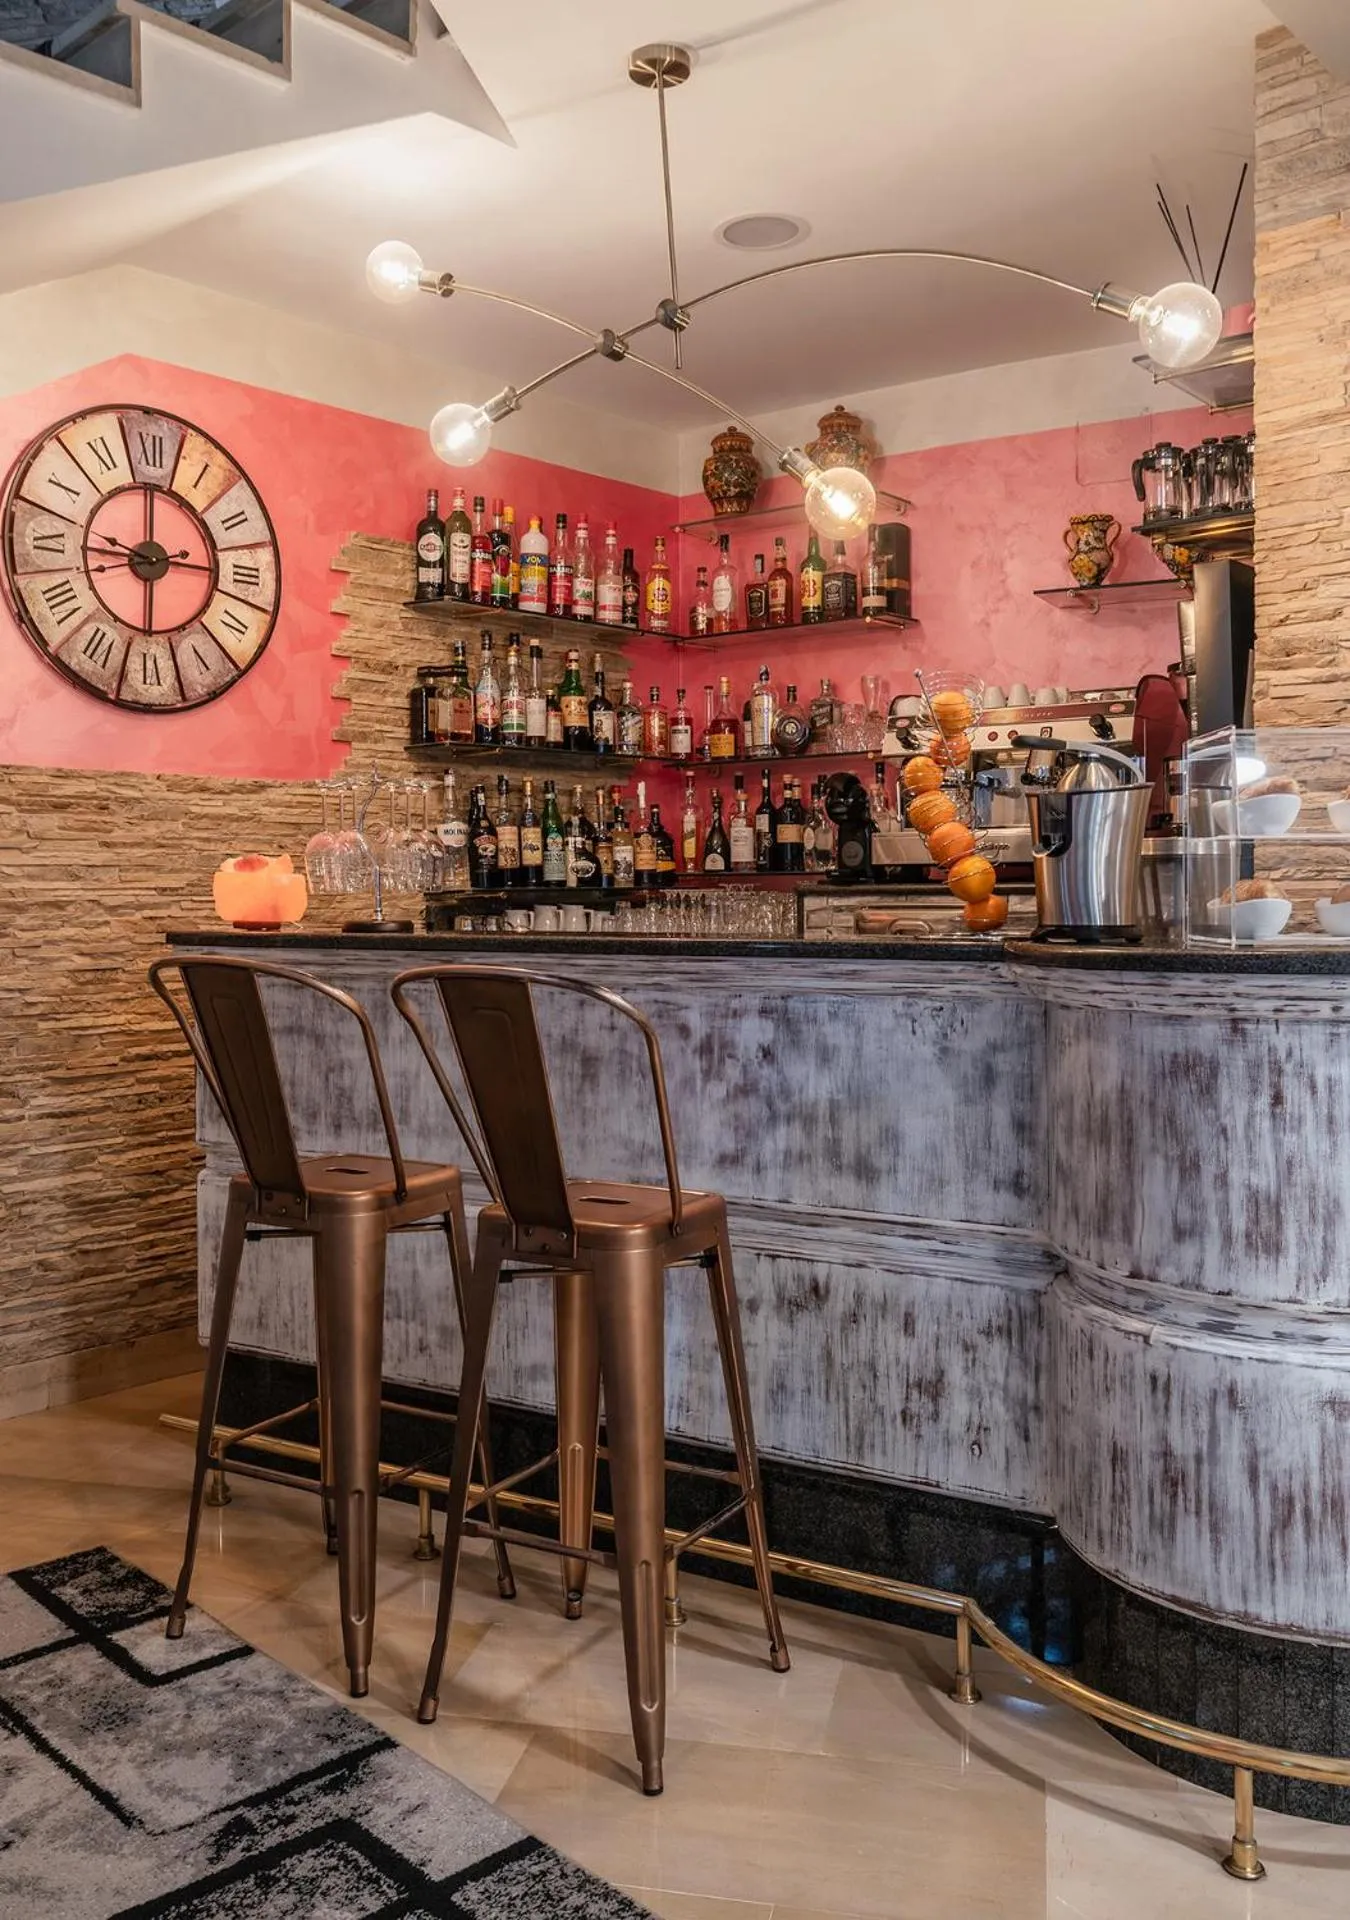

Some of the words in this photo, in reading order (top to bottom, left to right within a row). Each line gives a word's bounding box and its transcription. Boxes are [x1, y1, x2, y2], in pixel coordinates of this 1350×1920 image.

[86, 436, 118, 475] XI
[138, 431, 163, 469] XII
[47, 472, 81, 504] X
[193, 463, 209, 489] I
[221, 510, 248, 532] II
[32, 528, 65, 554] IX
[232, 564, 259, 586] III
[41, 579, 82, 626] VIII
[220, 608, 249, 643] IV
[82, 625, 115, 669] VII
[187, 642, 210, 675] V
[141, 651, 163, 686] VI
